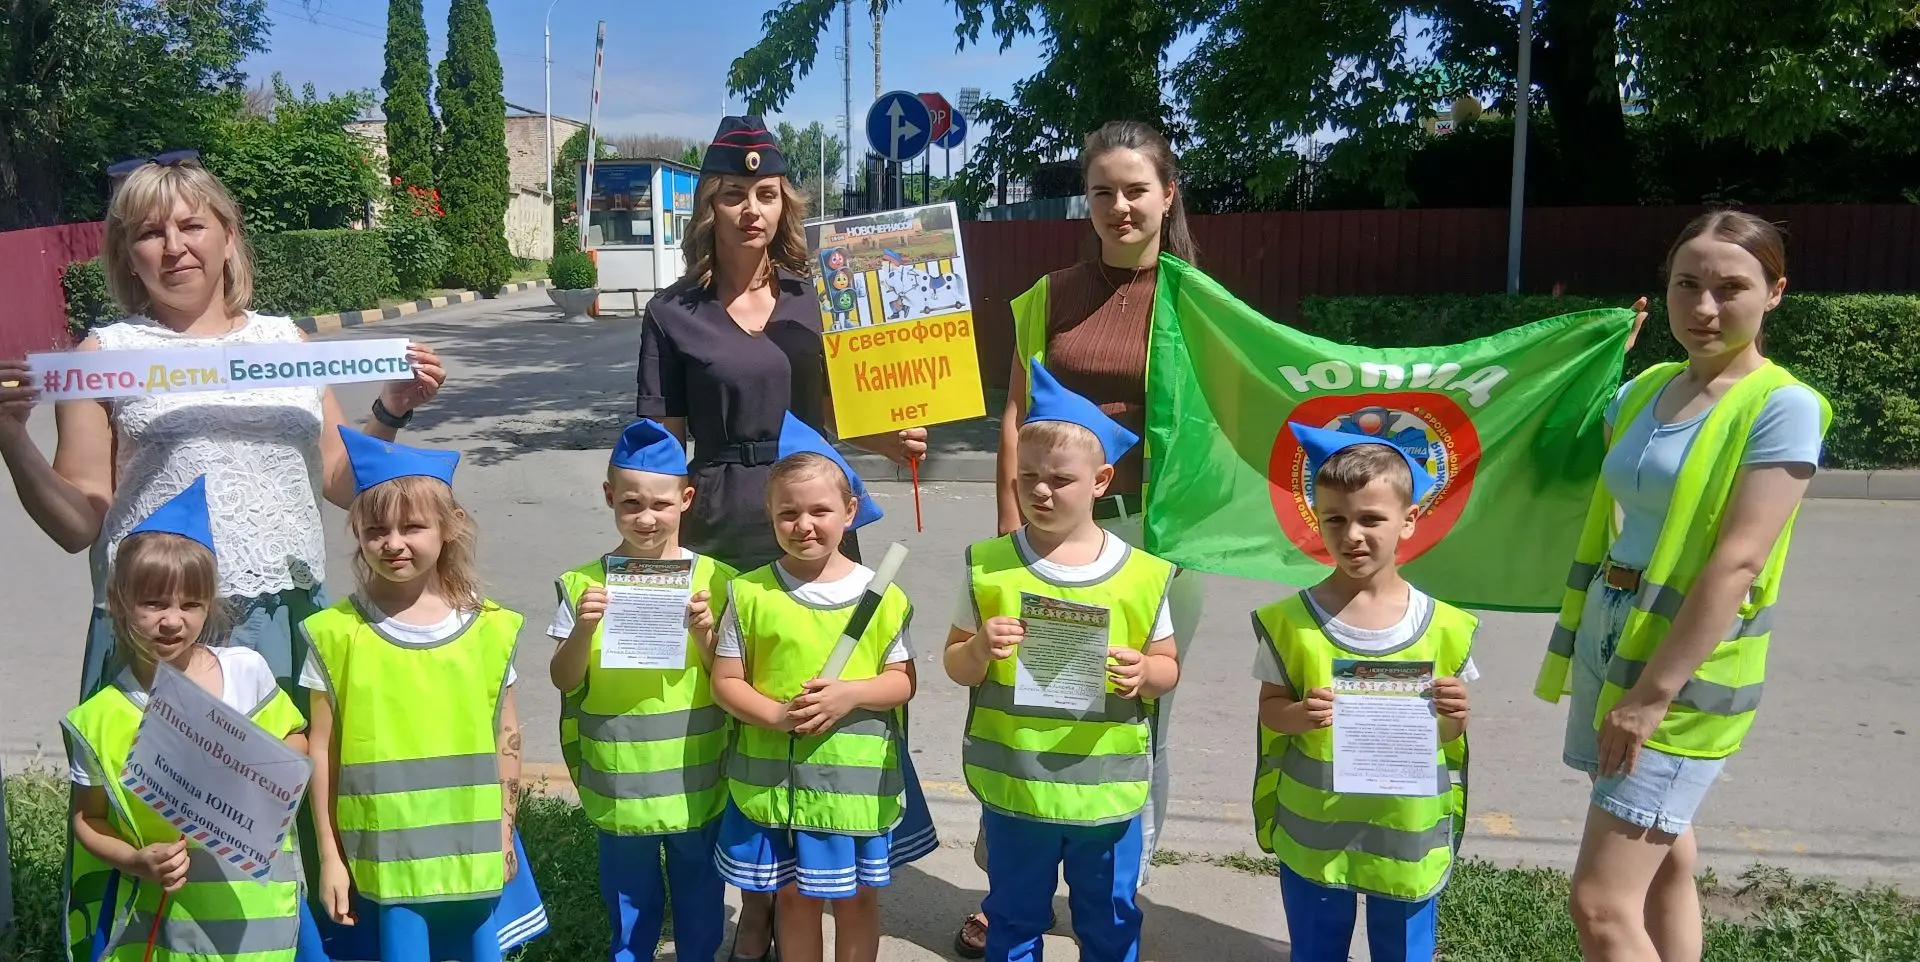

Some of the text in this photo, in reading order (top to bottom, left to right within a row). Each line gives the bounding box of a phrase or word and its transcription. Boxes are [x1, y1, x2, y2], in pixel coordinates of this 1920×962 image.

[930, 110, 946, 124] OP
[826, 319, 970, 359] У светофора
[854, 355, 952, 392] Каникул
[1278, 360, 1509, 408] ЮПИД
[891, 402, 928, 422] нет
[1291, 445, 1304, 503] ОСТОВСКАЯ
[1297, 503, 1319, 532] ОБЛАС
[205, 708, 247, 742] Акция
[151, 698, 291, 802] #ПисьмоВодителю
[154, 754, 256, 833] Команда ЮПИД
[127, 761, 272, 867] «Огоньки безопасности»
